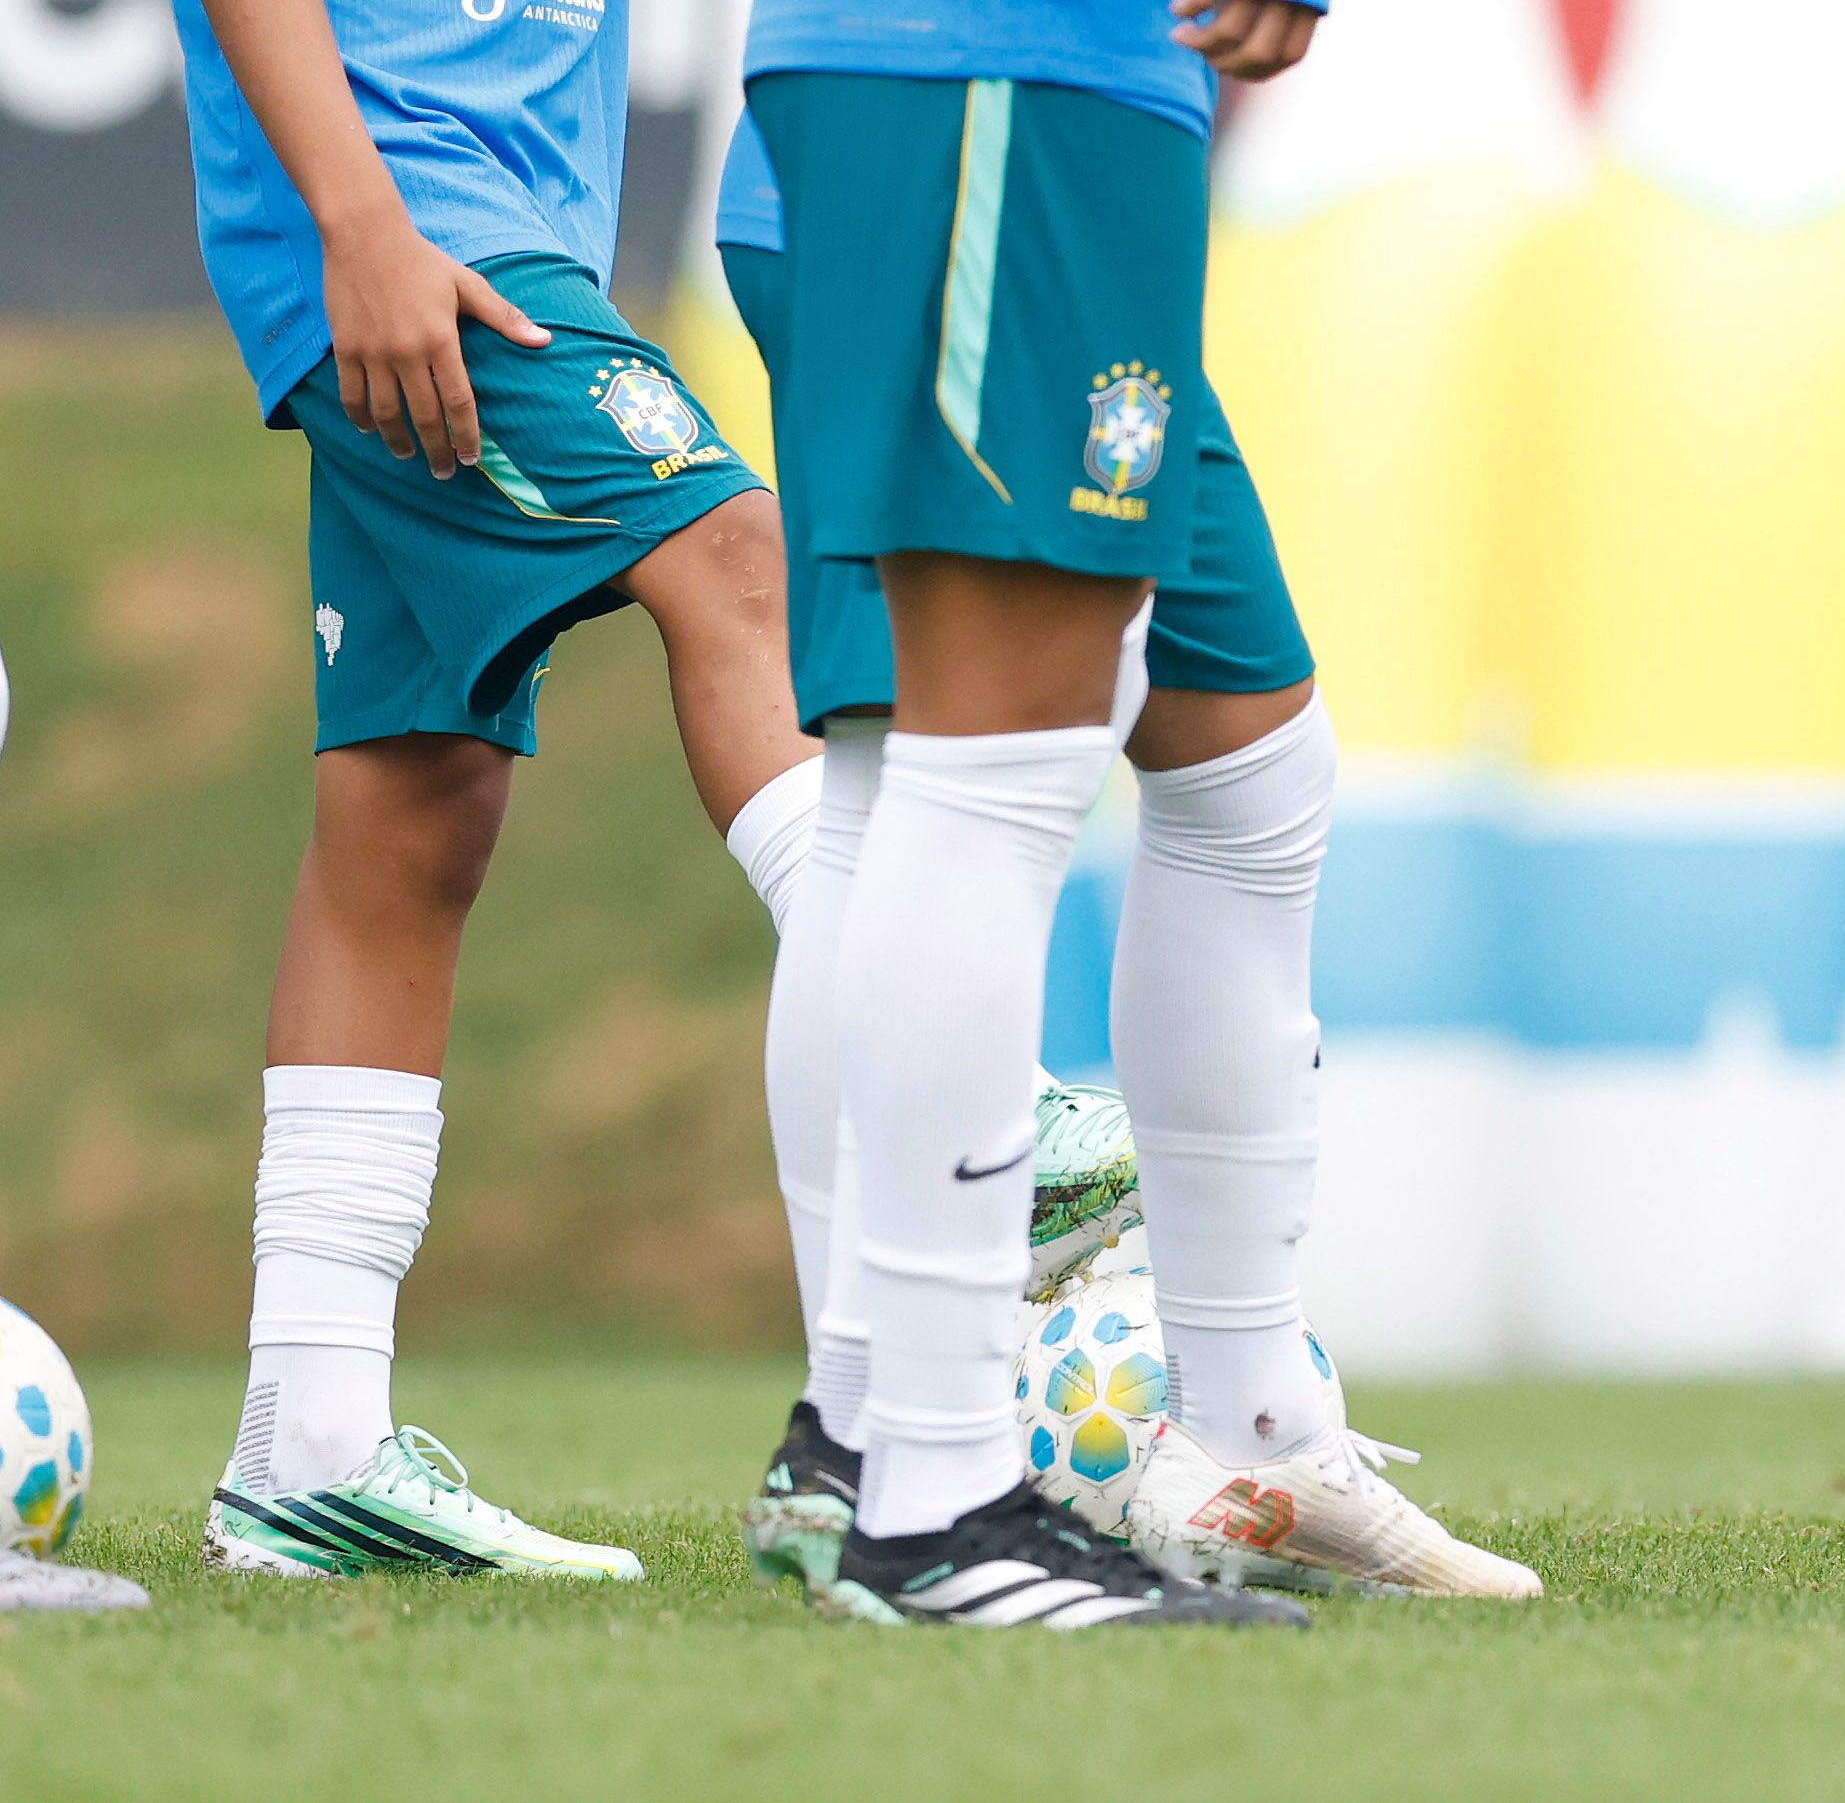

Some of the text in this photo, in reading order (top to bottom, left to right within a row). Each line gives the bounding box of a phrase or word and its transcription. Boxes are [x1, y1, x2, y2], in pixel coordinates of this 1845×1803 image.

[522, 4, 600, 33] ANTARCTICA
[638, 402, 664, 421] CBF
[651, 445, 729, 481] BRASIL
